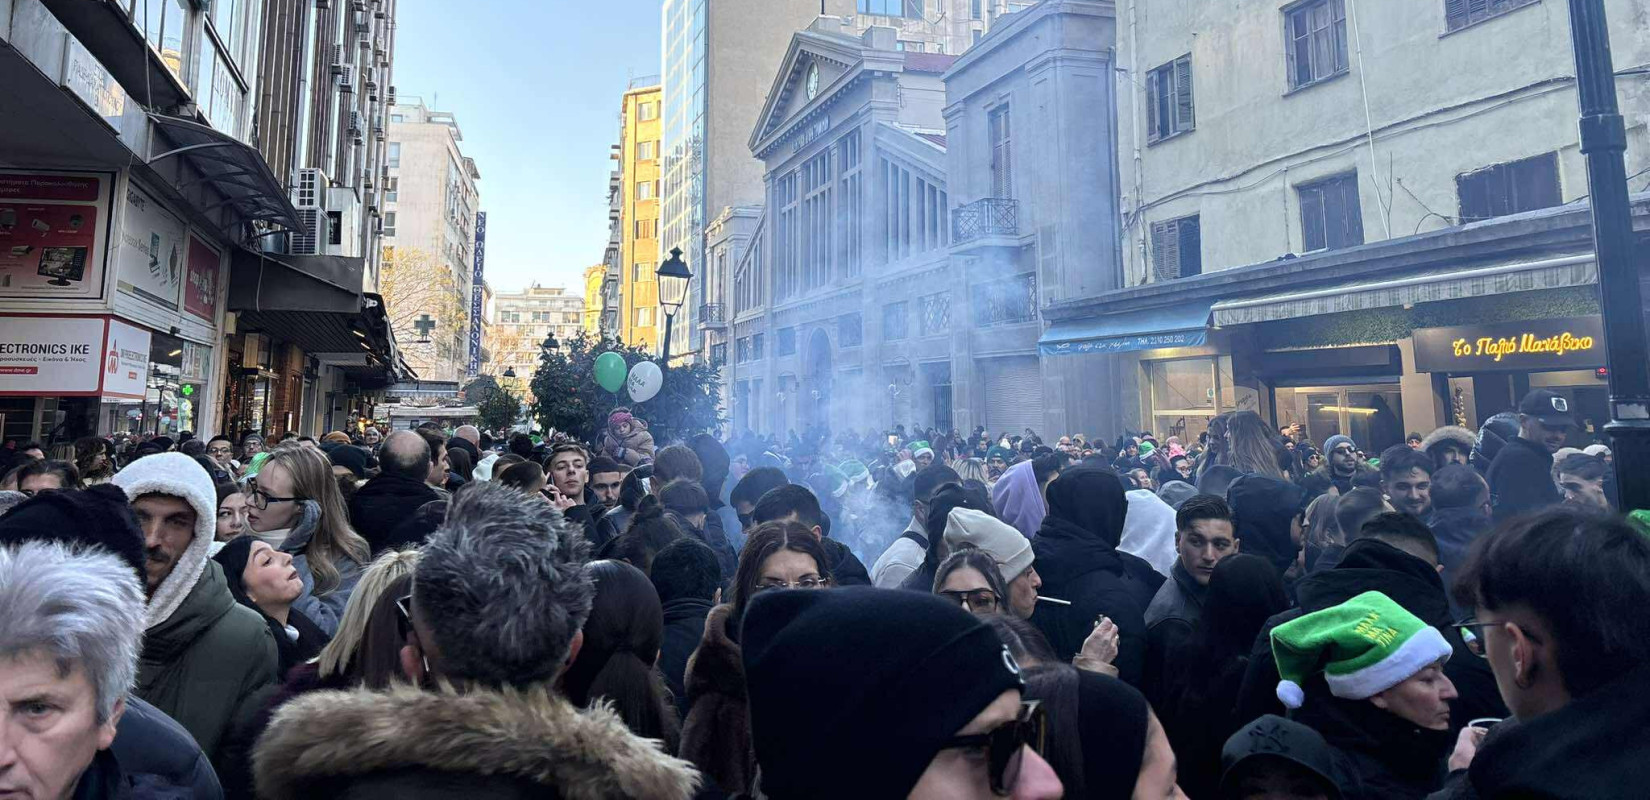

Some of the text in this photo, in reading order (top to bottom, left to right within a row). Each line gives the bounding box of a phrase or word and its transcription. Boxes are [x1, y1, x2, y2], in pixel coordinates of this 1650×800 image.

[469, 212, 485, 377] ΝΕΟ ΩΔΕΙΟ ΘΕΣΣΑΛΟΝΙΚΗΣ
[70, 344, 90, 355] IKE
[1518, 332, 1593, 356] Μανάβικο
